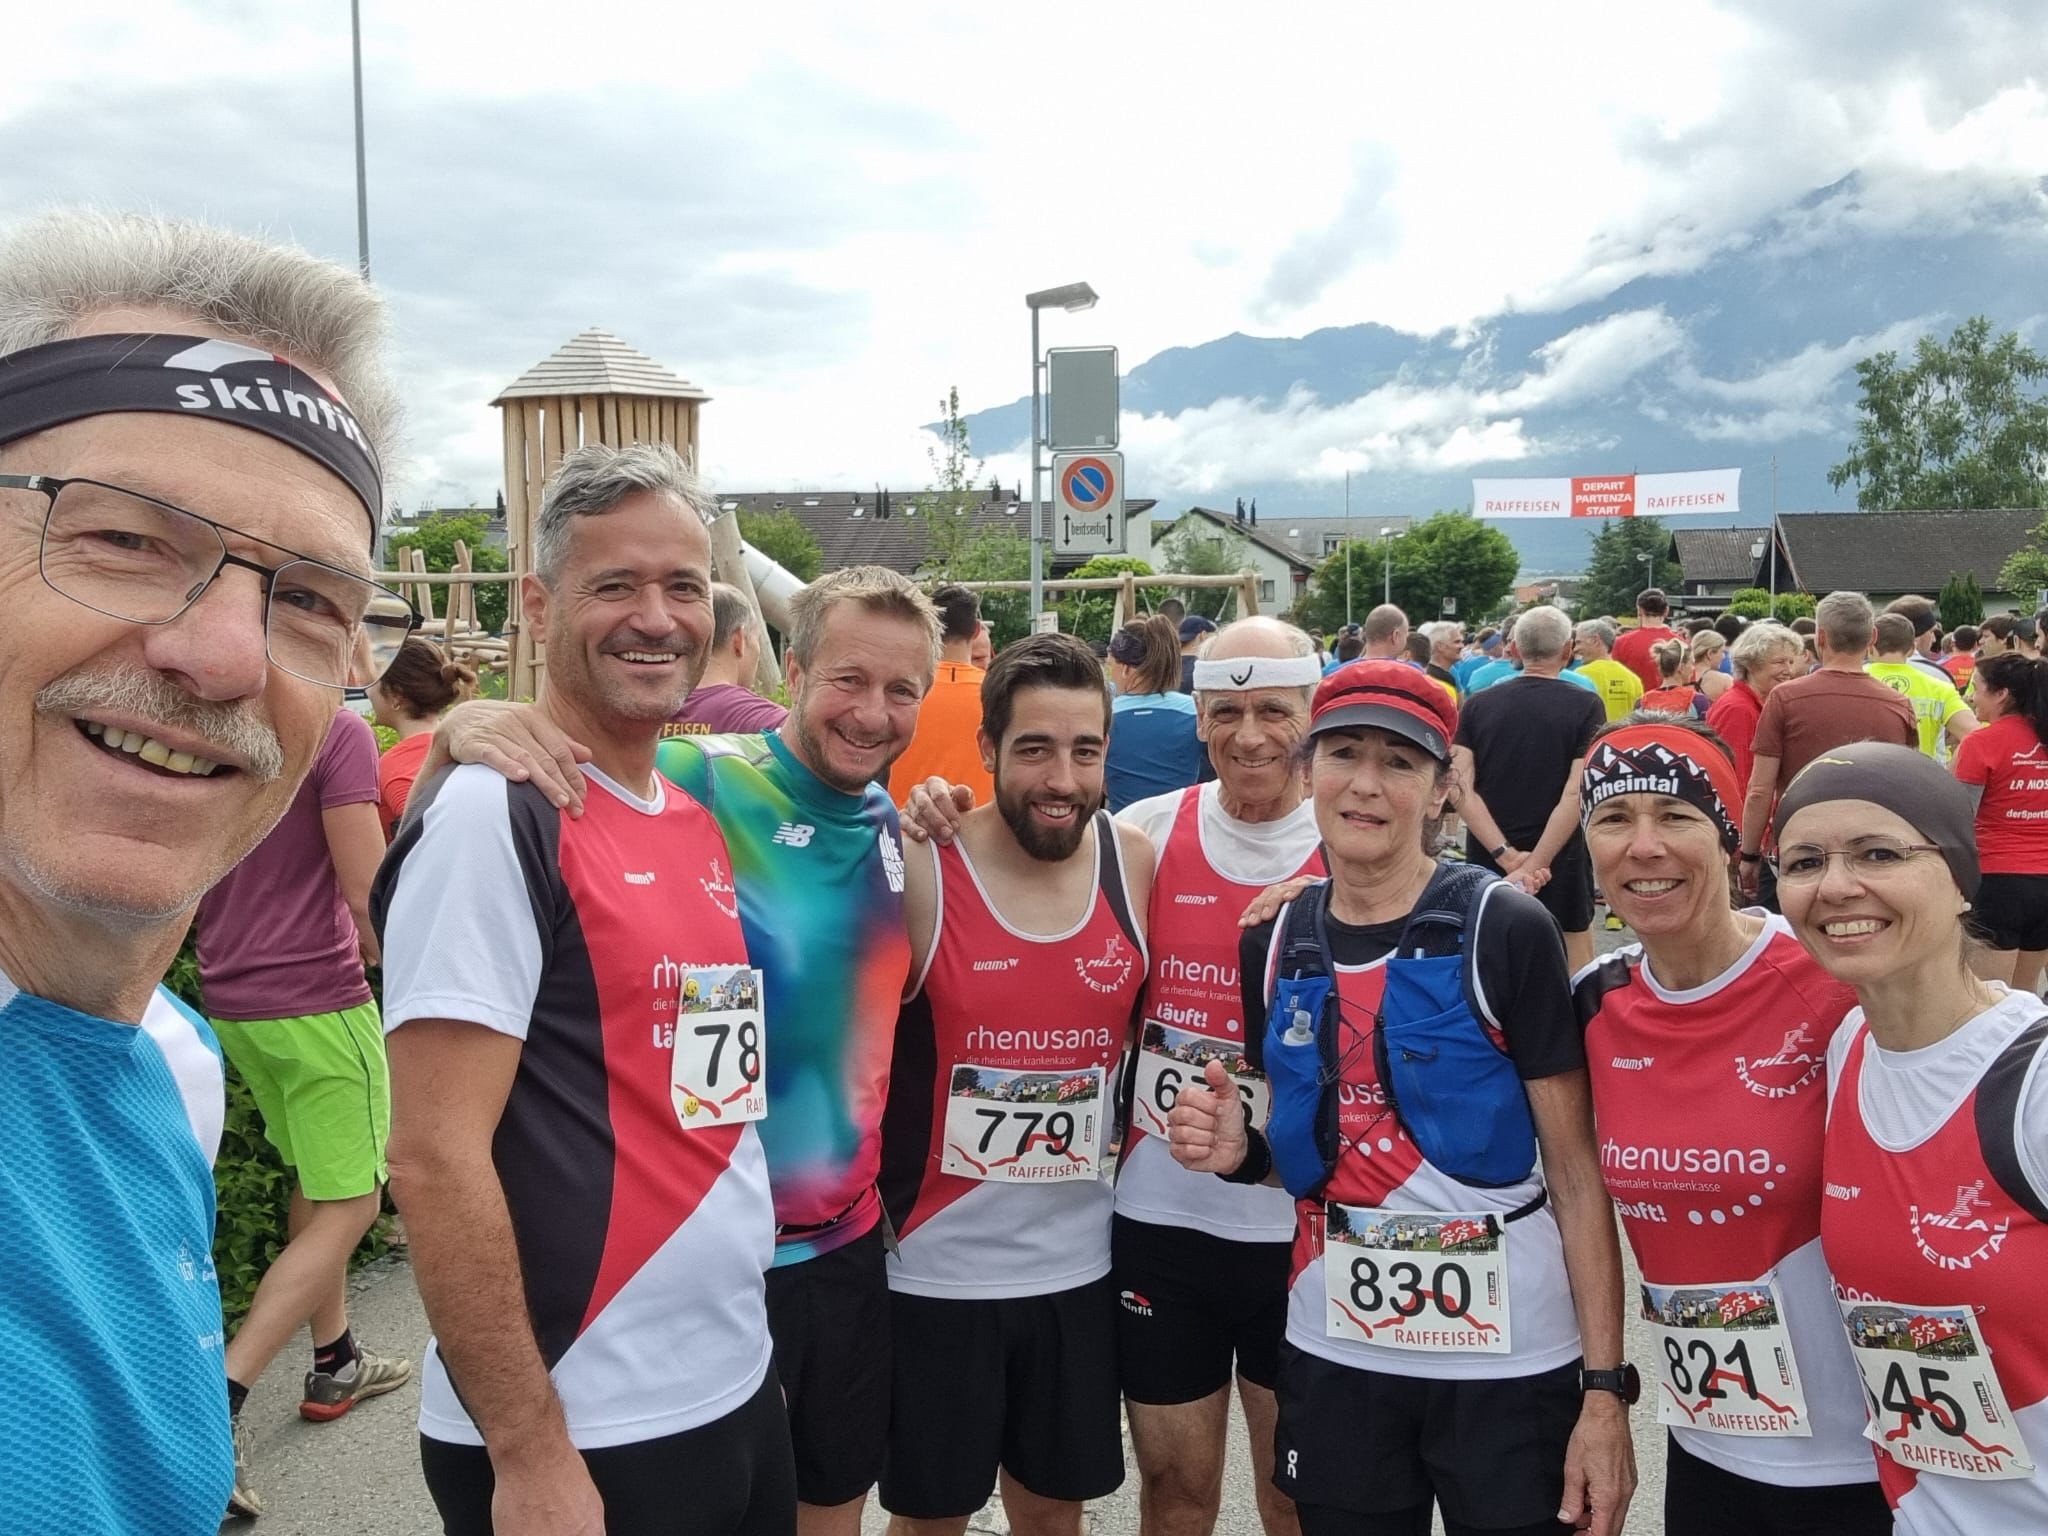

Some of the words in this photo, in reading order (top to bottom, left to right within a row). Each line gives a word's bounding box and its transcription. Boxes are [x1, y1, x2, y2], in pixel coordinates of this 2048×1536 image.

[175, 377, 368, 450] skinfit
[1582, 481, 1625, 491] DEPART
[1485, 500, 1560, 512] RAIFFEISEN
[1575, 493, 1633, 504] PARTENZA
[1649, 493, 1725, 508] RAIFFEISEN
[1585, 506, 1622, 516] START
[1075, 955, 1133, 994] RHEINTAL
[1160, 954, 1241, 987] rhenu
[653, 999, 668, 1011] die
[1156, 1001, 1208, 1029] läuft!
[1023, 1055, 1076, 1065] krankenkasse
[975, 1108, 1074, 1156] 779
[1008, 1163, 1081, 1178] RAIFFEISEN
[1652, 1178, 1721, 1192] krankenkasse
[1910, 1205, 2009, 1270] RHEINTAL
[1350, 1257, 1471, 1318] 830
[1395, 1328, 1488, 1346] RAIFFEISEN
[1664, 1336, 1758, 1400] 821
[1708, 1412, 1789, 1431] RAIFFEISEN
[1901, 1443, 2002, 1473] RAIFFEISEN
